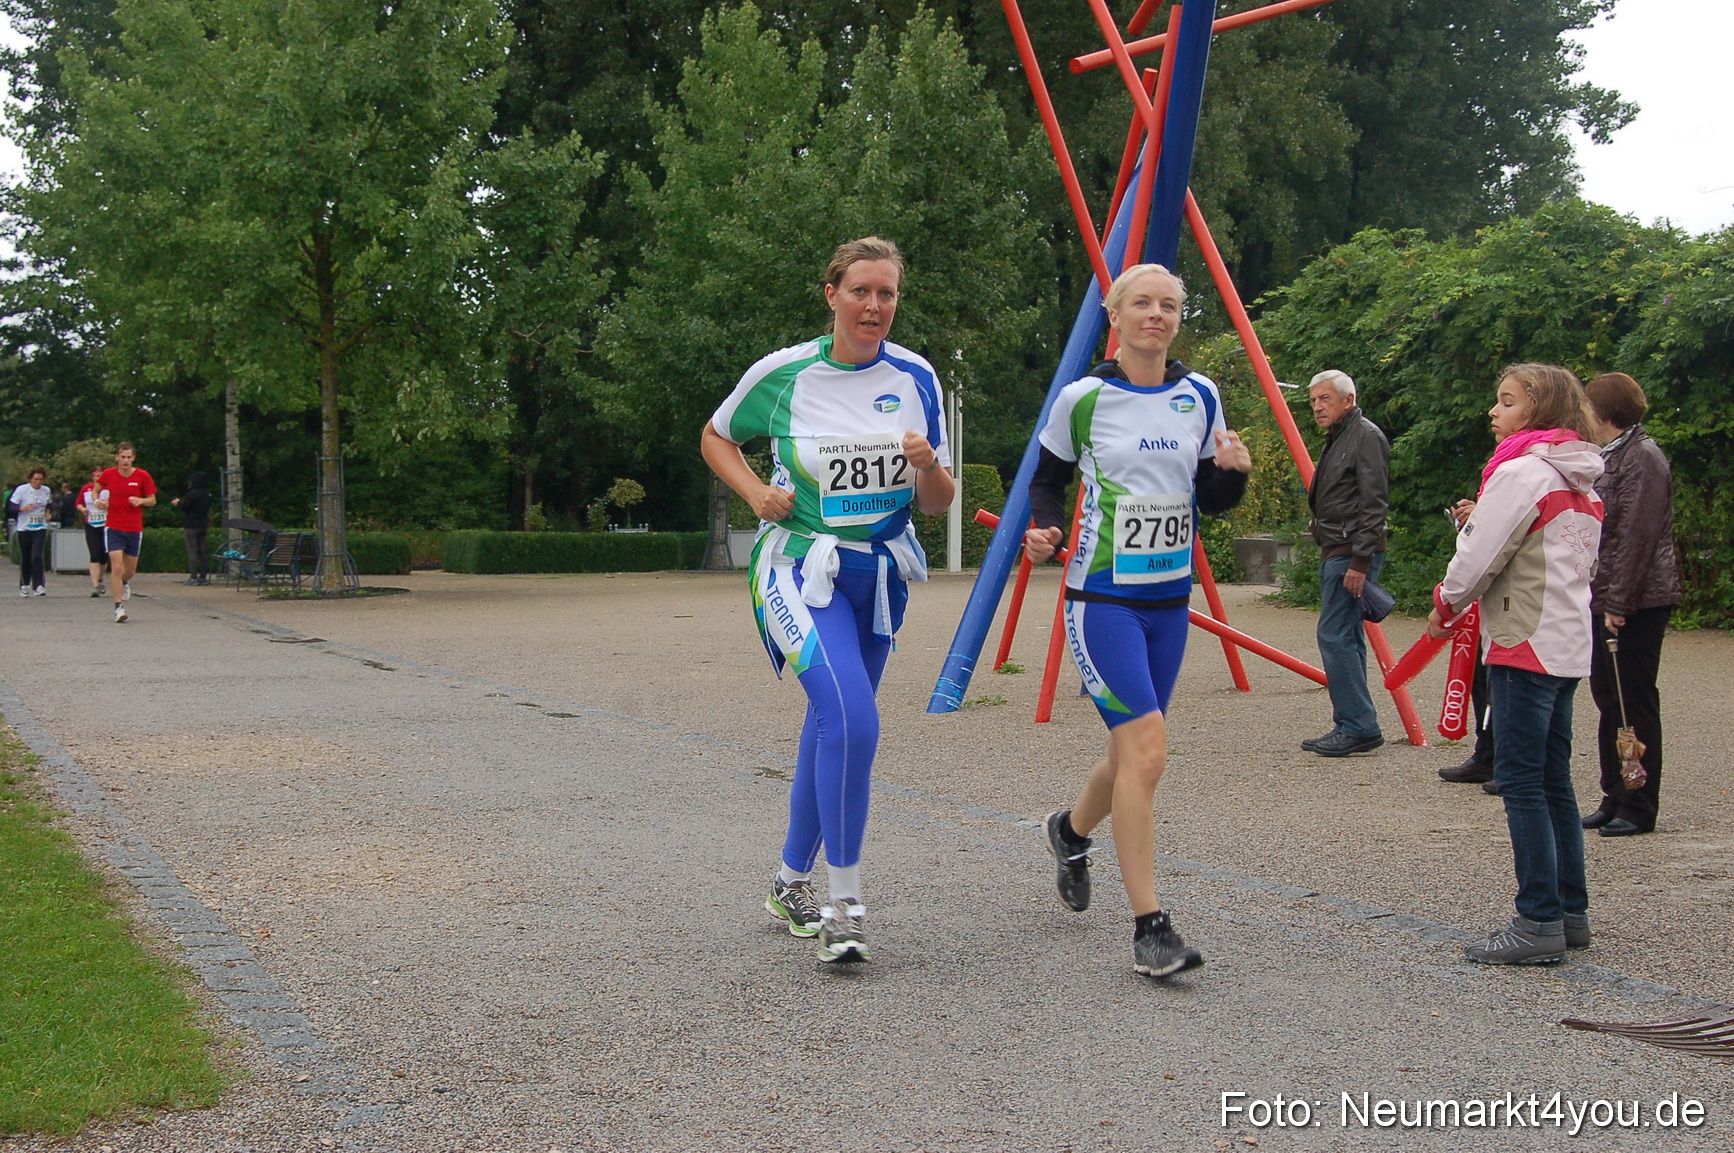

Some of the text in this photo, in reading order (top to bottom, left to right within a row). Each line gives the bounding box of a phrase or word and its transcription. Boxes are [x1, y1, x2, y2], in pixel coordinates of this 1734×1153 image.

[819, 441, 900, 455] PARTL Neumarkt
[1138, 436, 1179, 451] Anke
[829, 454, 908, 491] 2812
[842, 497, 896, 513] Dorothea
[1125, 513, 1190, 549] 2795
[1147, 557, 1174, 570] Anke
